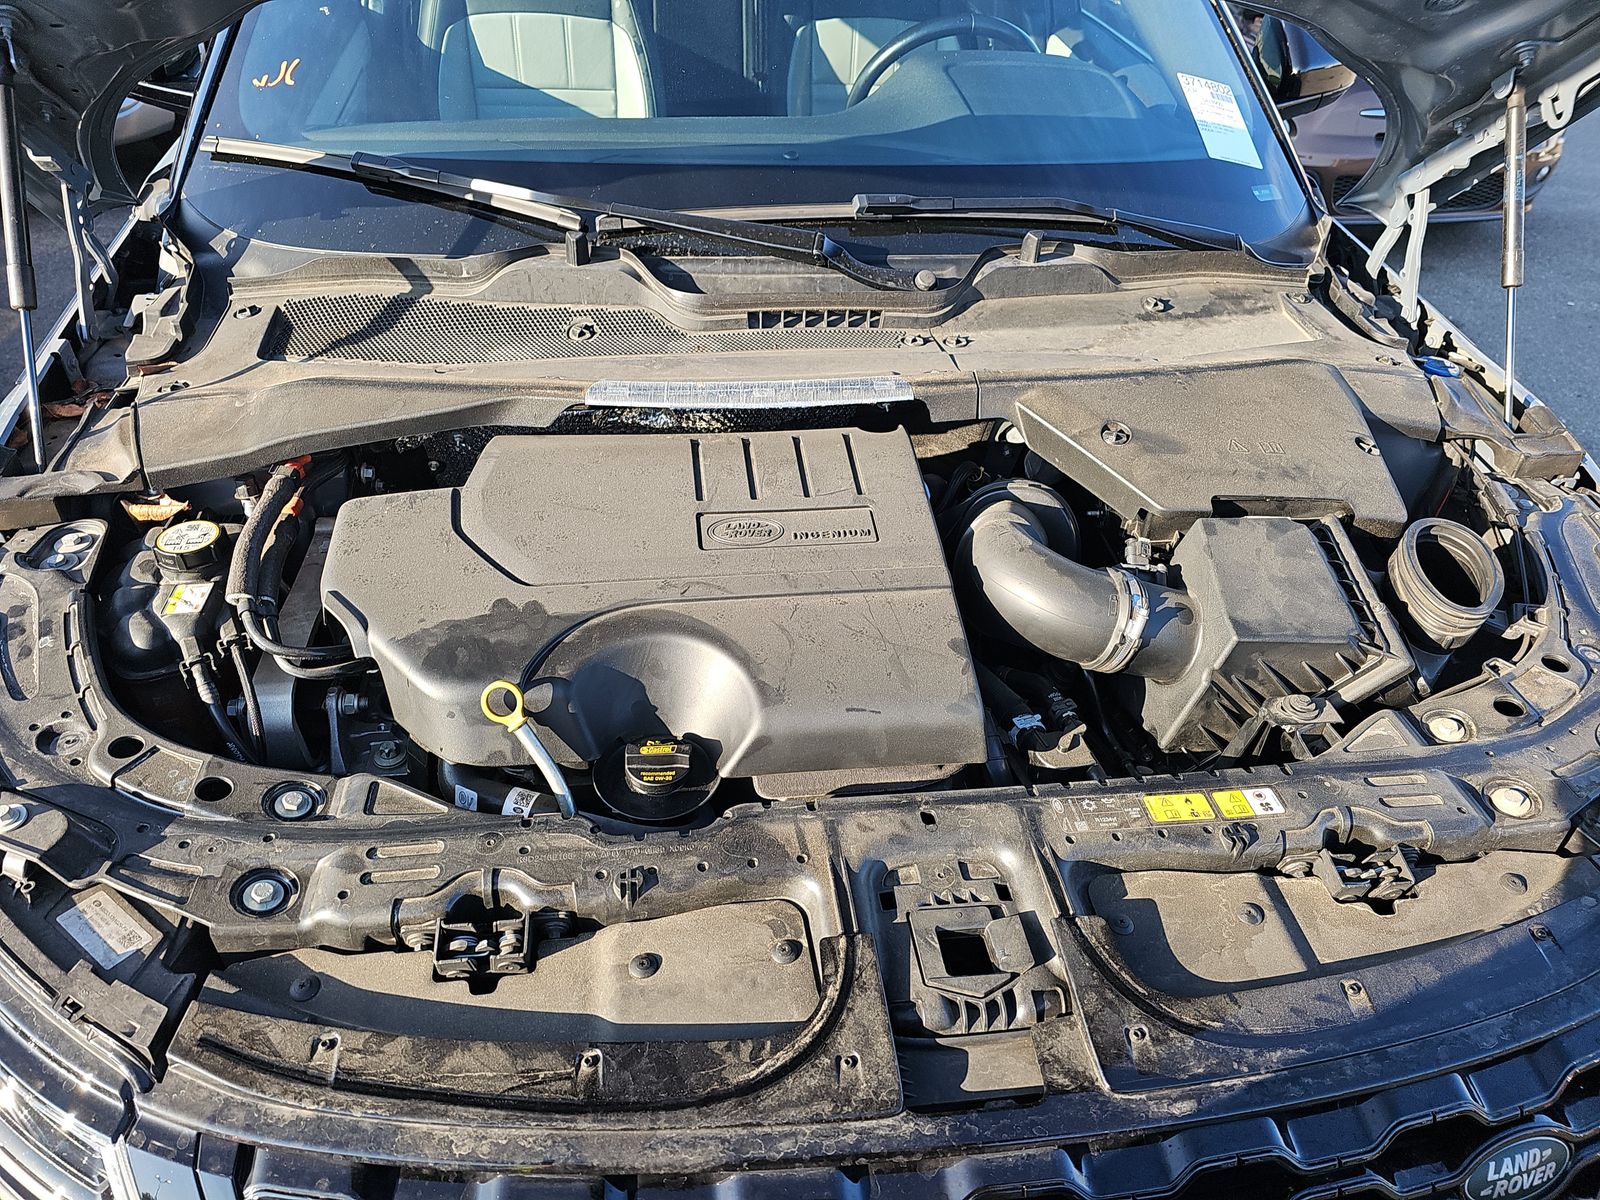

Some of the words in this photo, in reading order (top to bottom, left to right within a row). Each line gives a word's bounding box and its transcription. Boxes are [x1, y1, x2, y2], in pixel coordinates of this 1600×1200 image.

[1181, 74, 1233, 96] 3714802
[726, 521, 762, 530] LAND
[728, 529, 773, 539] ROVER
[792, 528, 872, 540] INGENIUM
[1487, 1148, 1541, 1182] LAND
[1492, 1161, 1557, 1199] ROVER
